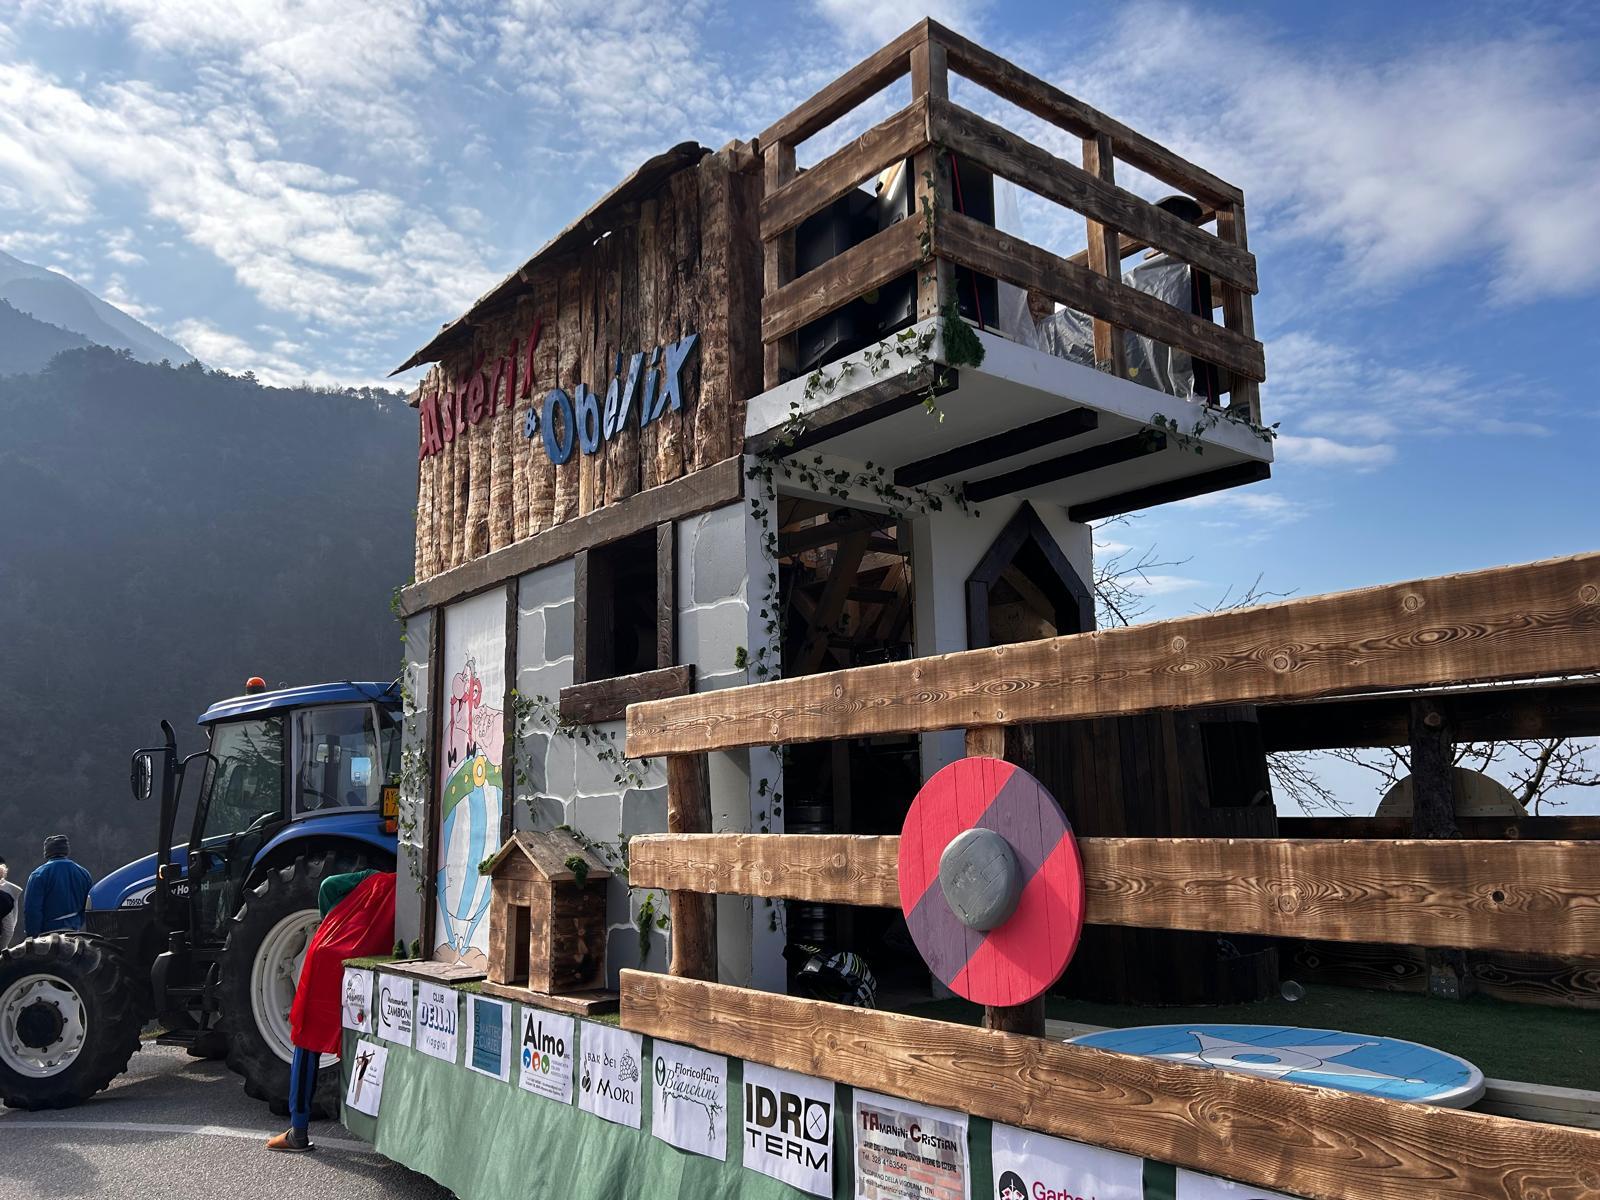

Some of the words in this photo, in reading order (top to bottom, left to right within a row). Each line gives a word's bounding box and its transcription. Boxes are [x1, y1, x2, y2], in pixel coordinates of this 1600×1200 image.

[432, 992, 445, 1004] CLUB
[387, 1004, 412, 1021] ZAMBONI
[523, 1012, 565, 1058] Almo
[587, 1052, 601, 1064] BAR
[674, 1062, 720, 1085] Floricoltura
[665, 1068, 718, 1101] Bianchini
[746, 1127, 828, 1173] TERM
[884, 1175, 899, 1185] DELLA
